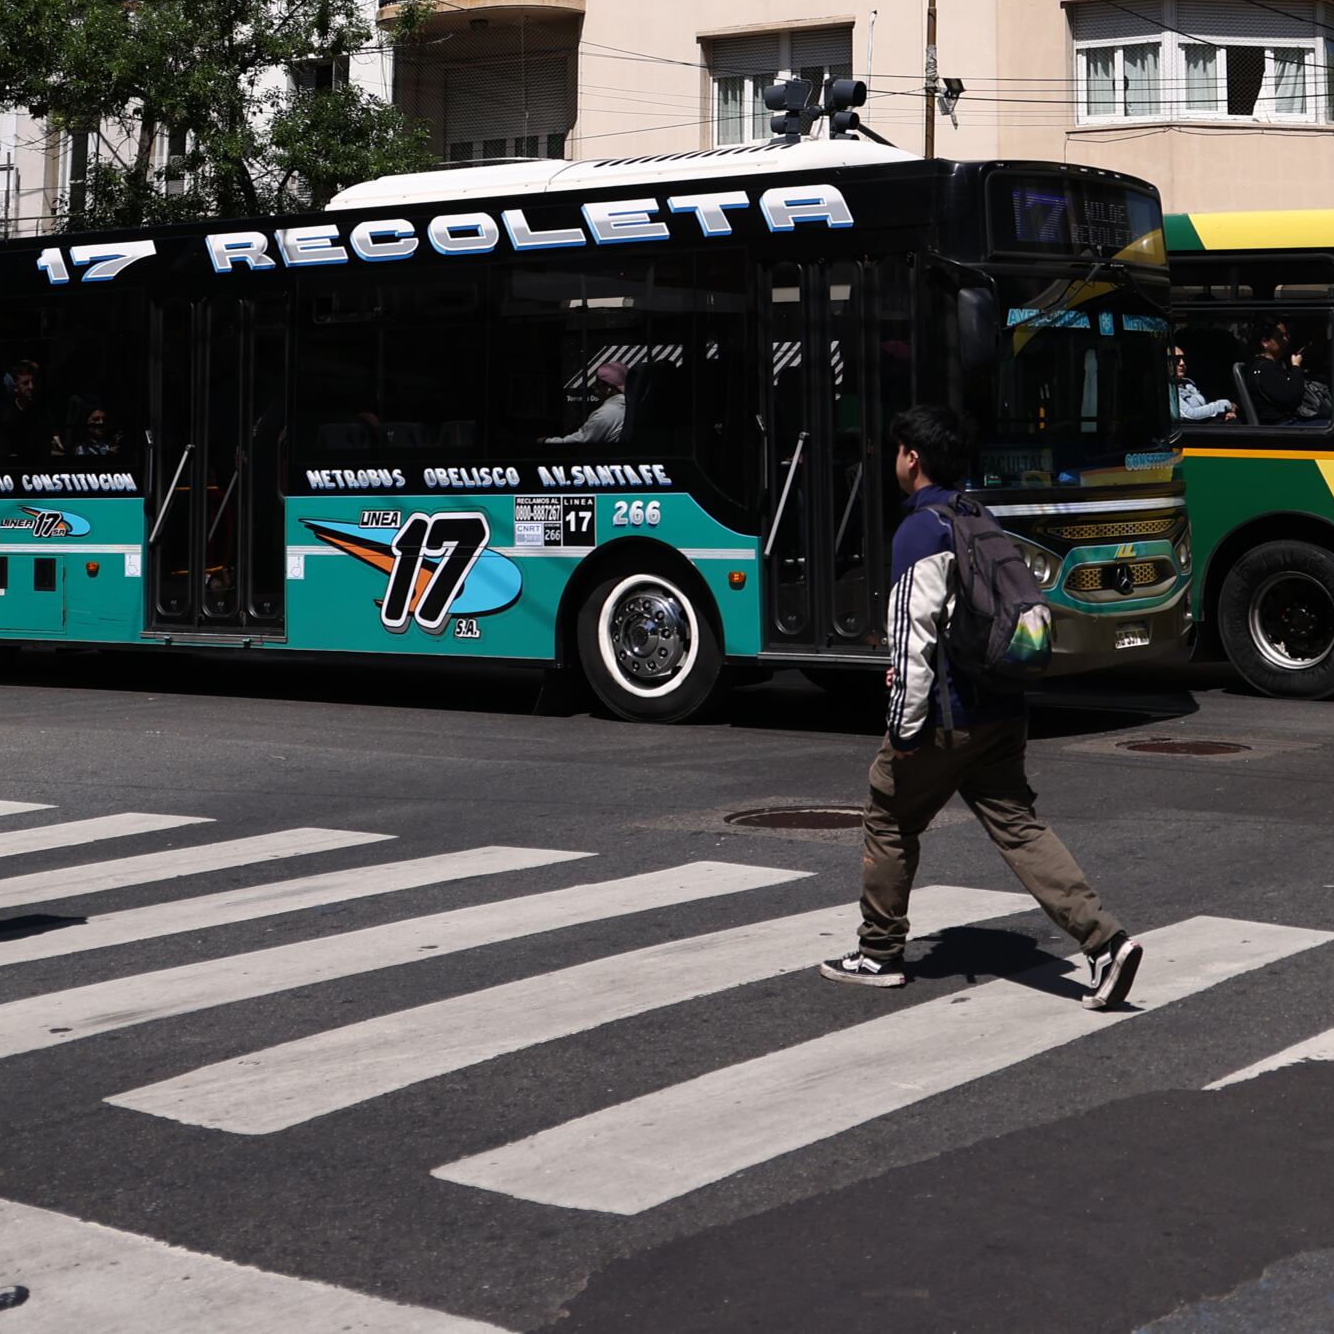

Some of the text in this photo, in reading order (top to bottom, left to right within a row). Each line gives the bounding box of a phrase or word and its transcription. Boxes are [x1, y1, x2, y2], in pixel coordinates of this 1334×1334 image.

[37, 239, 156, 284] 17
[204, 184, 853, 273] RECOLETA
[22, 472, 137, 492] CONSTITUCION
[306, 468, 406, 489] METROBUS
[423, 467, 520, 488] OBELISCO
[360, 511, 400, 527] LINEA
[516, 505, 560, 521] 0800-8887267
[565, 511, 592, 532] 17
[612, 500, 661, 527] 266
[0, 519, 34, 529] LINEA
[33, 511, 62, 537] 17
[545, 529, 561, 541] 266
[381, 511, 490, 633] 17
[454, 619, 480, 638] S.A.
